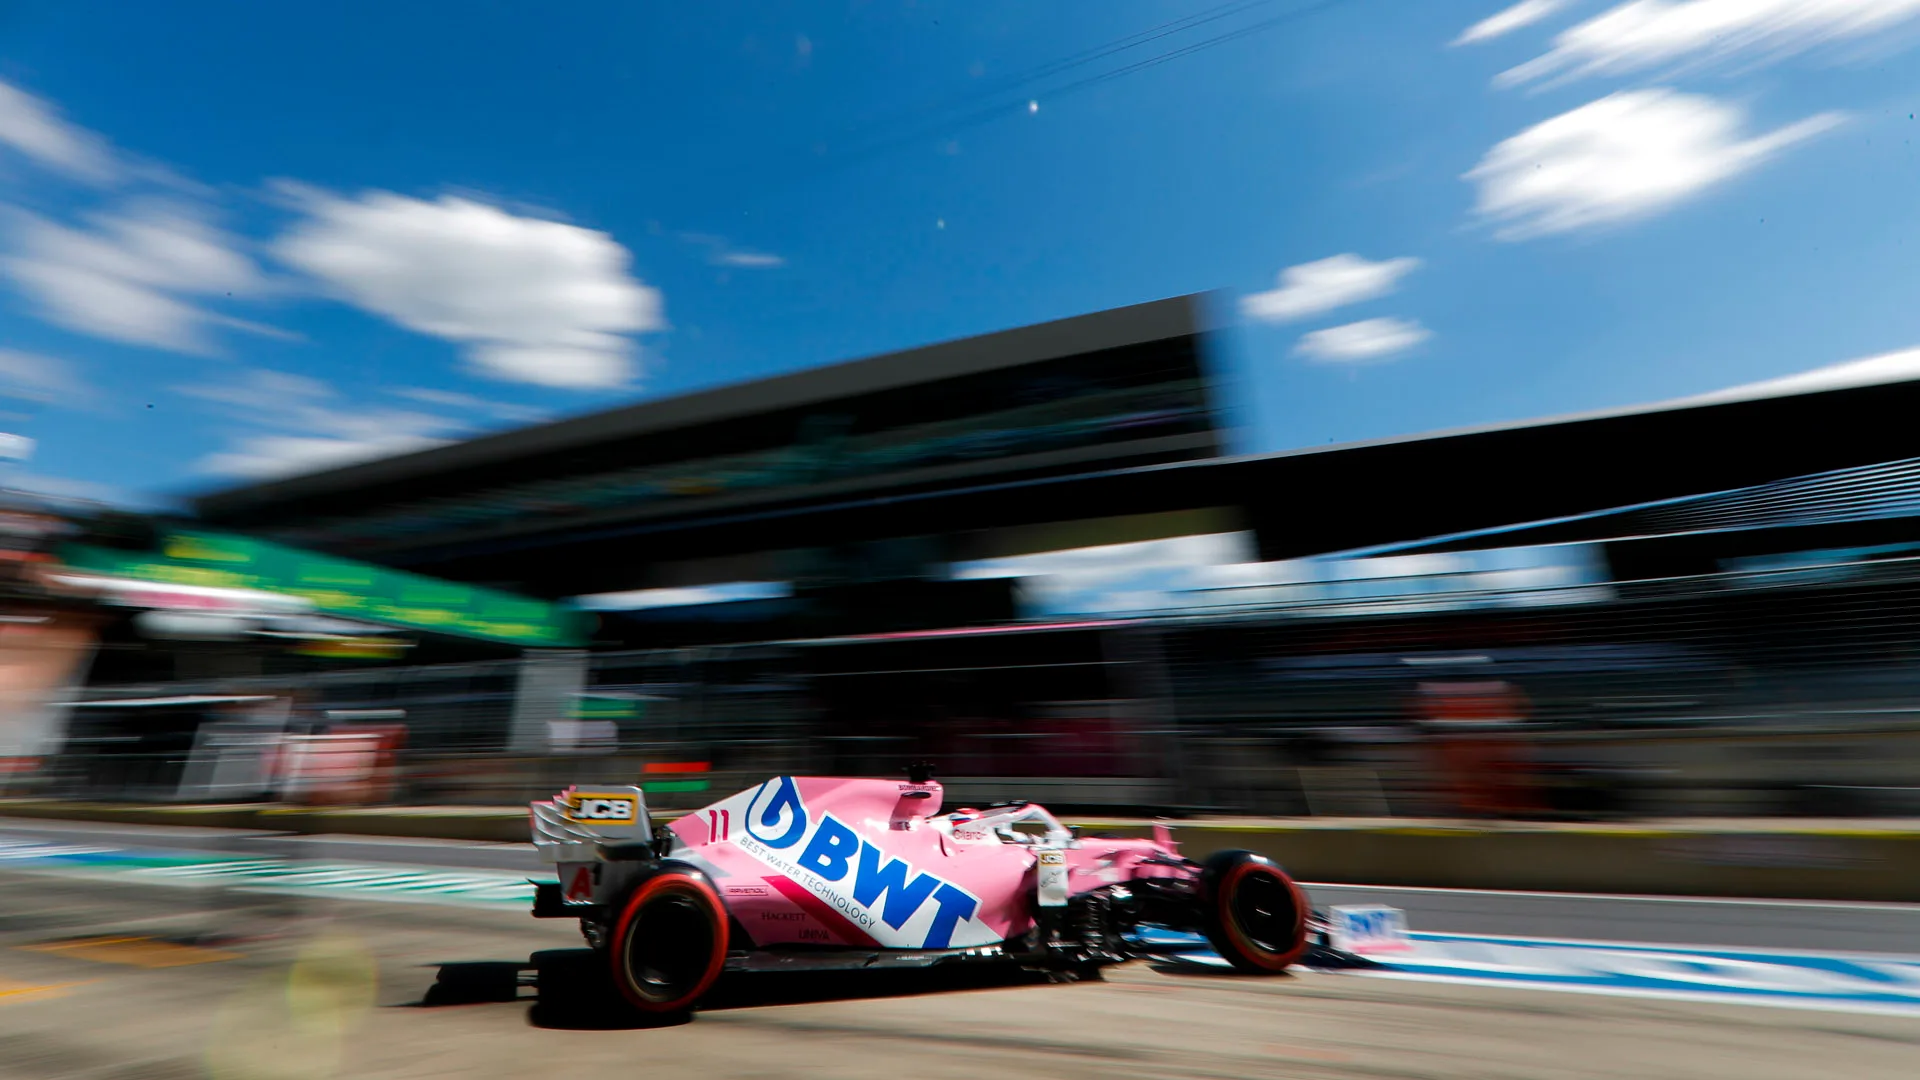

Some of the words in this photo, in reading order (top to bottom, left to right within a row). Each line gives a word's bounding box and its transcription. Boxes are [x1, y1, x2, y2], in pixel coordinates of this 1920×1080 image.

[571, 799, 632, 819] JCB
[708, 809, 729, 843] 11
[740, 836, 767, 856] BEST
[766, 854, 800, 877] WATER
[803, 873, 876, 929] TECHNOLOGY
[799, 815, 977, 949] BWT
[761, 911, 806, 921] HACKETT
